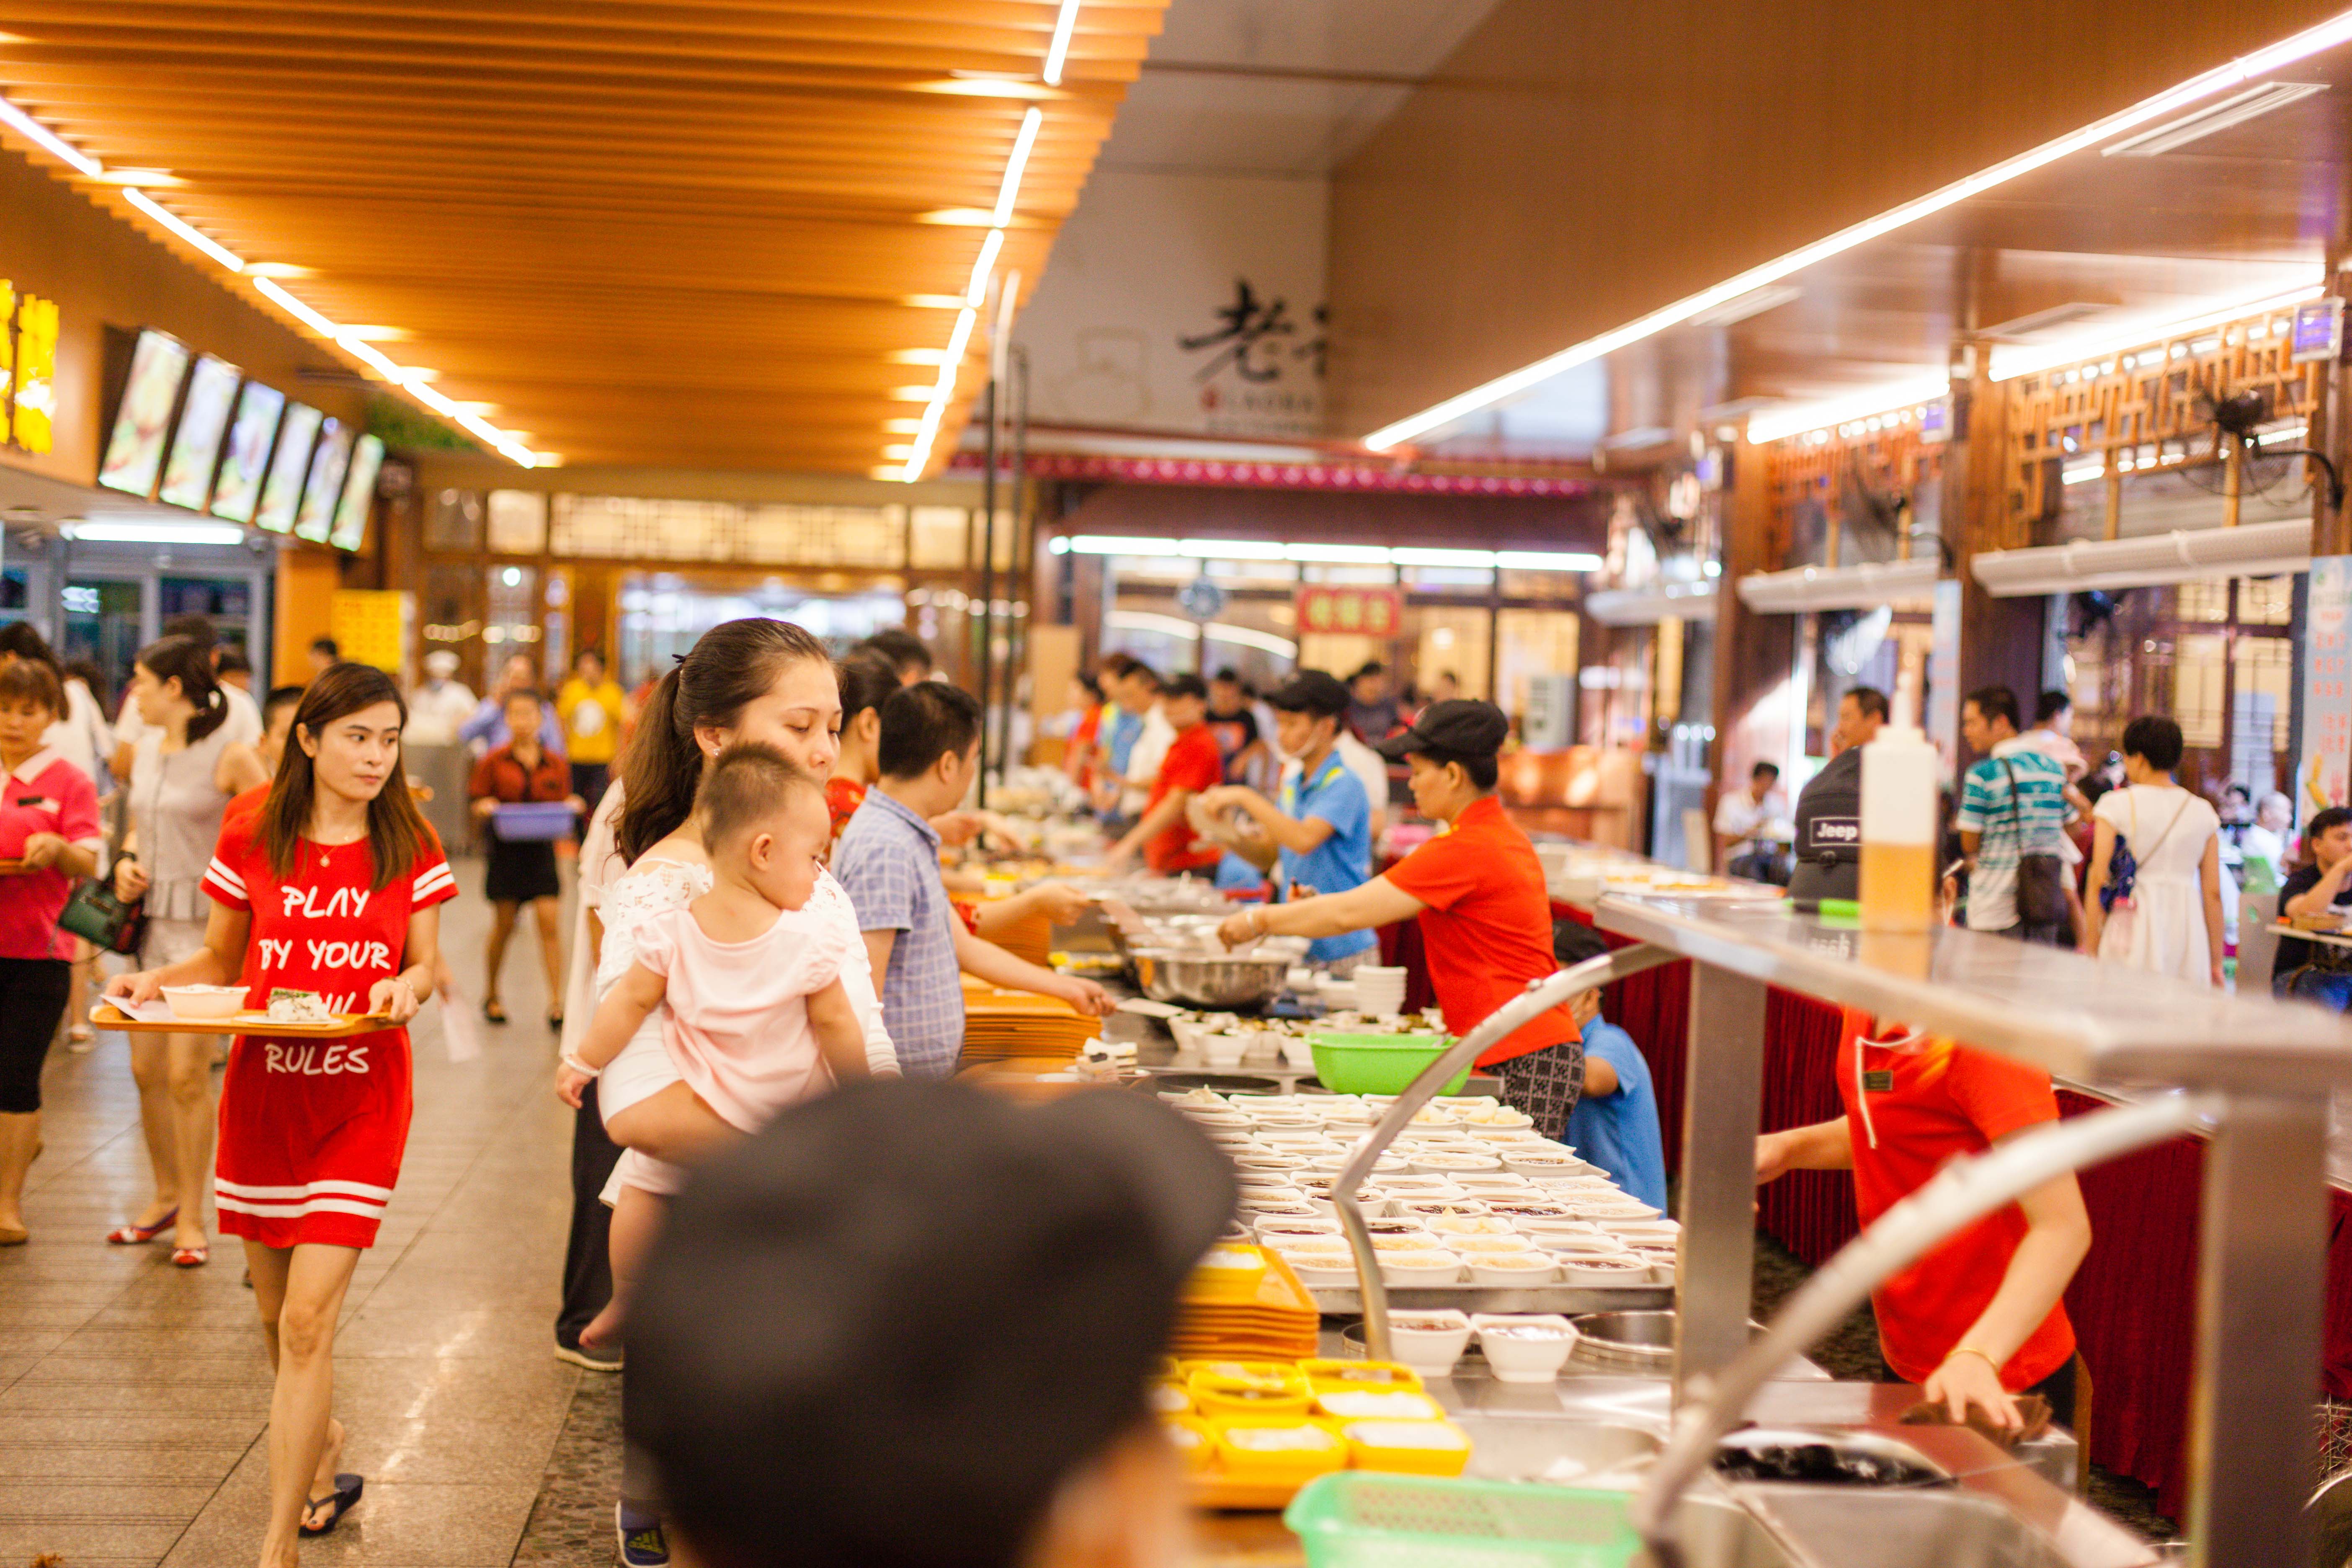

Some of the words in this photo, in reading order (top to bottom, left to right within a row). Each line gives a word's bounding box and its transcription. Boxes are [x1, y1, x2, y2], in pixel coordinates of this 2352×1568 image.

[1817, 823, 1858, 841] Jeep
[280, 885, 371, 918] PLAY
[258, 938, 293, 971] BY
[307, 938, 392, 971] YOUR
[264, 1043, 370, 1075] RULES
